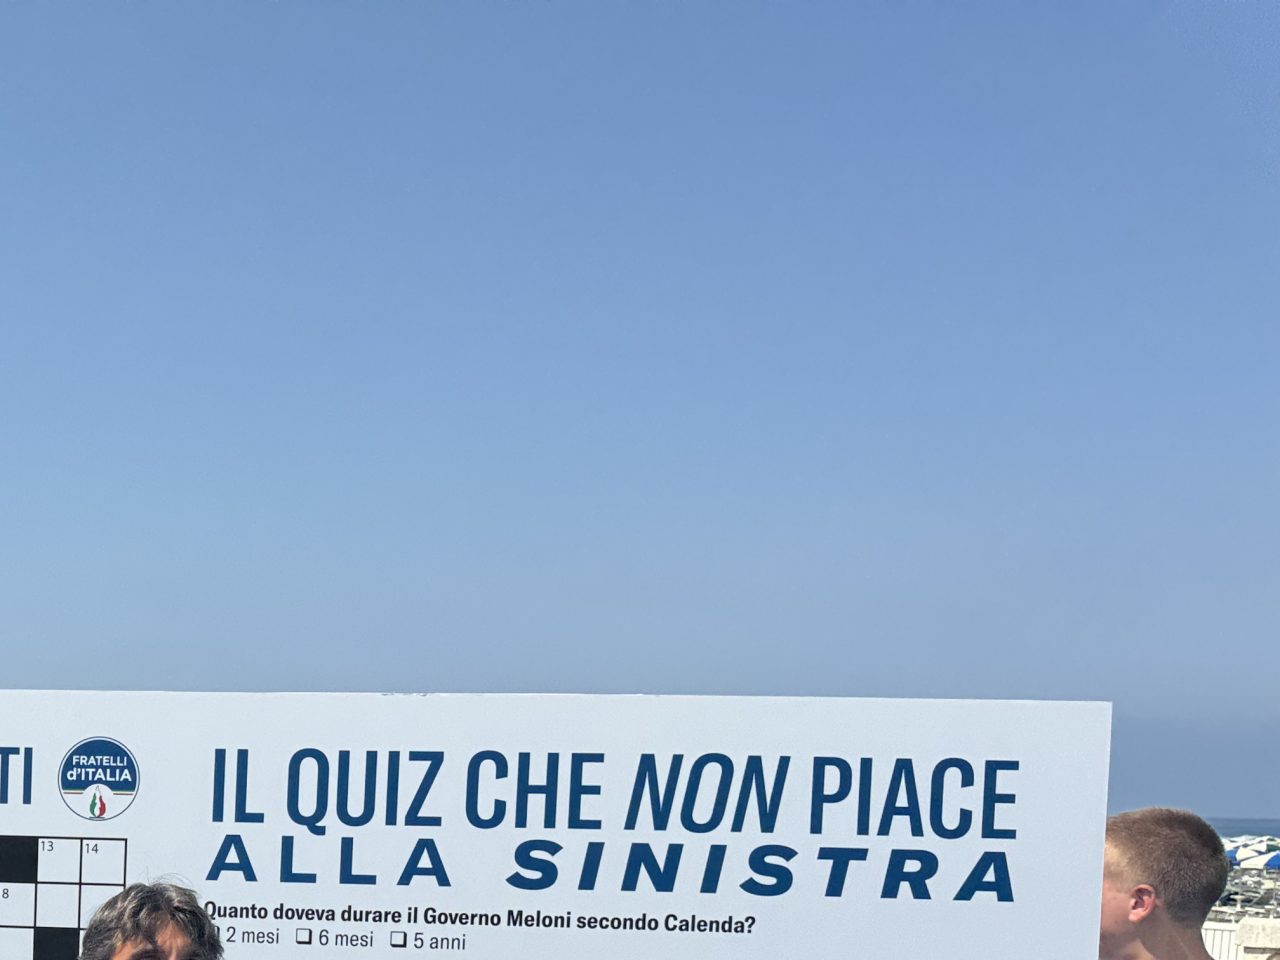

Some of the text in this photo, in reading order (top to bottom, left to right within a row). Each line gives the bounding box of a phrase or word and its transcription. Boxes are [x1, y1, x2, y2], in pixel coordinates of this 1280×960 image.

[72, 755, 127, 766] FRATELLI
[66, 767, 132, 782] d'ITALIA
[212, 748, 1020, 840] IL QUIZ CHE NON PIACE
[86, 844, 98, 854] 14
[205, 834, 1015, 903] ALLA SINISTRA
[205, 901, 756, 933] Quanto doveva durare il Governo Meloni secondo Calenda?
[227, 926, 465, 950] 2 mesi 6 mesi 5 anni
